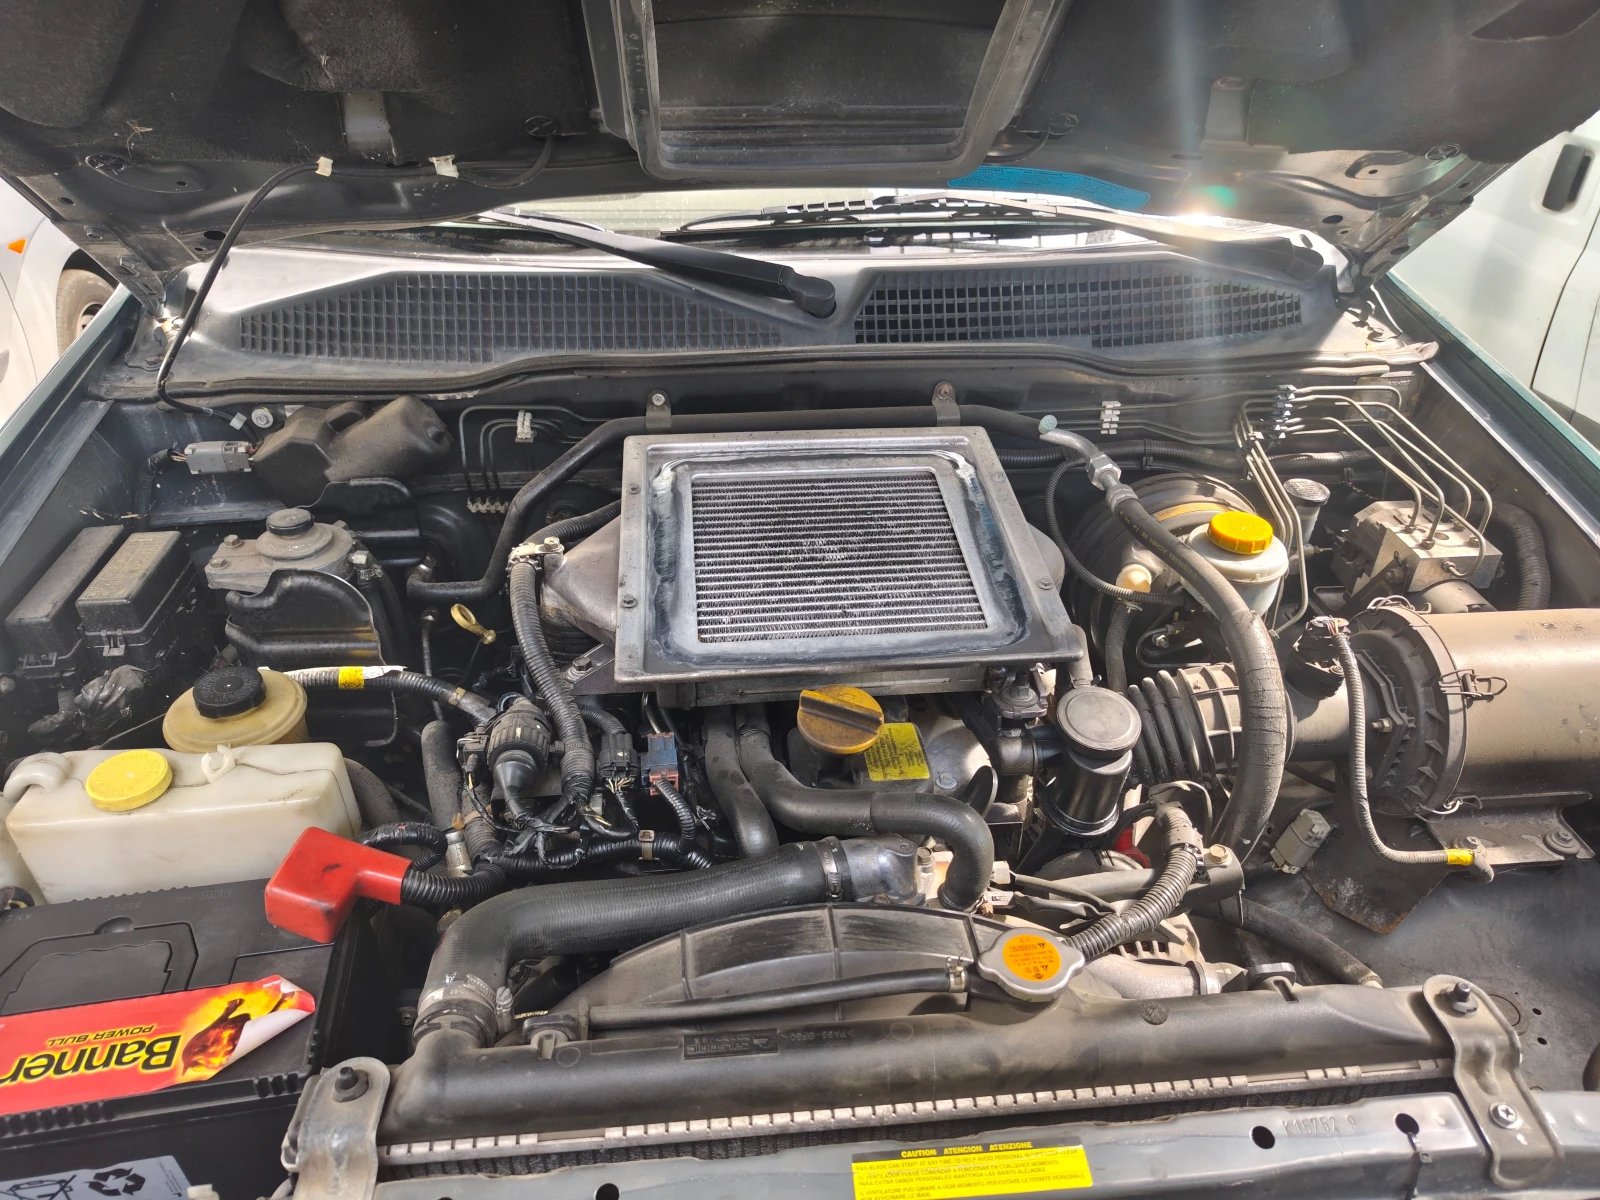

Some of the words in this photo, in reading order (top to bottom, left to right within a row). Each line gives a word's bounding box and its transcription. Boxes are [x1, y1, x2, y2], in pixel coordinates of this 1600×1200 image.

[48, 1034, 90, 1047] BULL
[93, 1025, 155, 1041] POWER
[0, 1034, 182, 1083] Banner
[901, 1149, 937, 1158] CAUTION
[944, 1146, 983, 1155] ATENCION
[989, 1142, 1033, 1151] ATENZIONE
[865, 1171, 900, 1179] VENTILADOR
[920, 1167, 951, 1175] COMENZAR
[957, 1164, 989, 1172] FUNCIONAR
[998, 1161, 1030, 1169] CUALQUIER
[915, 1174, 952, 1182] PERSONALES
[952, 1171, 983, 1179] MANTENGA
[865, 1187, 901, 1195] VENTILATORE
